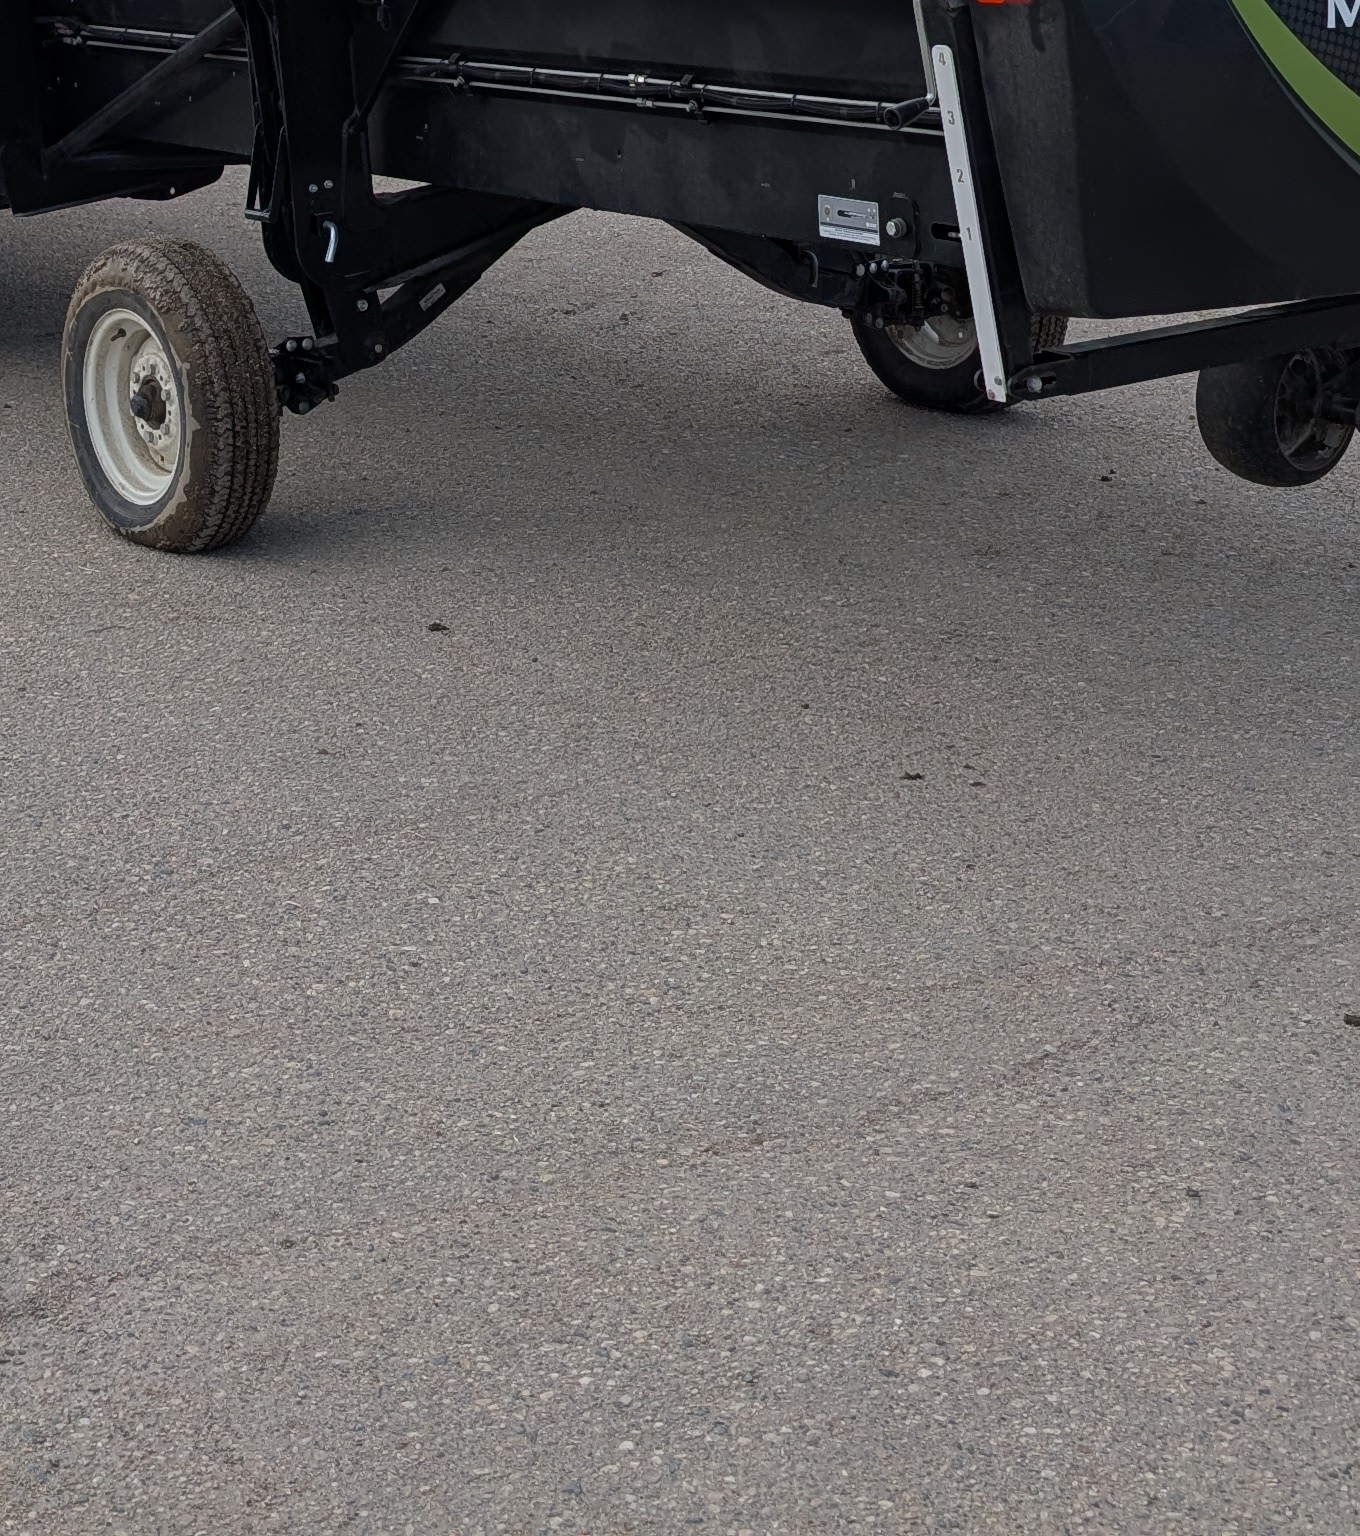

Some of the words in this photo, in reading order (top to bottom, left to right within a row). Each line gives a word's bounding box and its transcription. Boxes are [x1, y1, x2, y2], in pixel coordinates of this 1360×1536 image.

[938, 52, 947, 67] 4
[948, 110, 956, 126] 3
[956, 168, 965, 184] 2
[965, 226, 973, 242] 1
